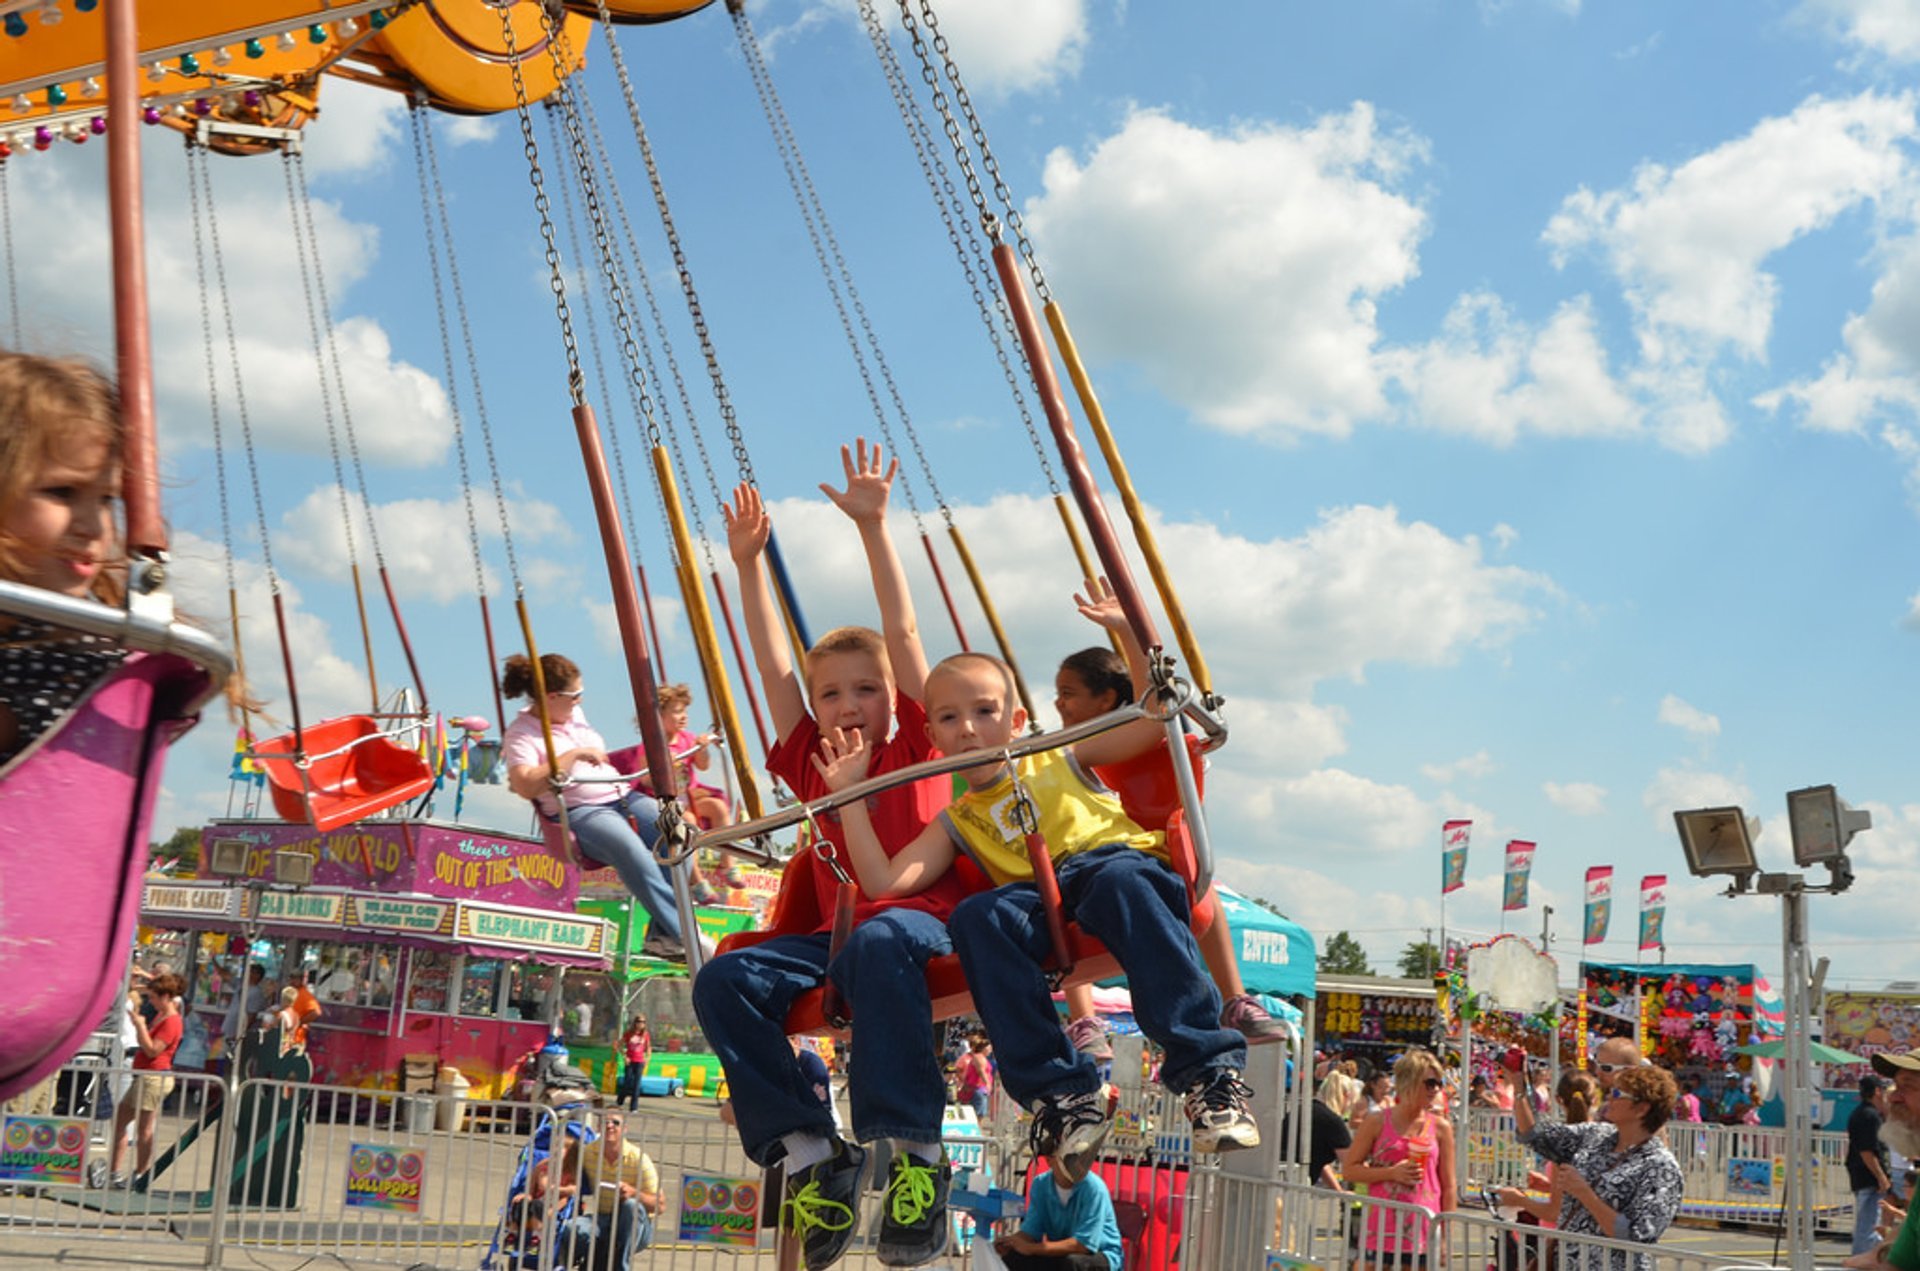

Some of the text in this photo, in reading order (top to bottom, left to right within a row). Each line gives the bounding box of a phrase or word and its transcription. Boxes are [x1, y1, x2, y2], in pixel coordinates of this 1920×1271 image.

[458, 838, 511, 859] they're
[247, 849, 271, 877] OF
[435, 852, 565, 889] OUT OF THIS WORLD
[260, 894, 332, 918] OLD DRINKS
[477, 914, 549, 942] ELEPHANT
[552, 924, 586, 946] EARS
[1243, 928, 1289, 965] ENTER
[3, 1151, 80, 1169] LOLLIPOPS
[349, 1176, 419, 1197] LOLLIPOPS
[682, 1210, 755, 1231] LOLLIPOPS
